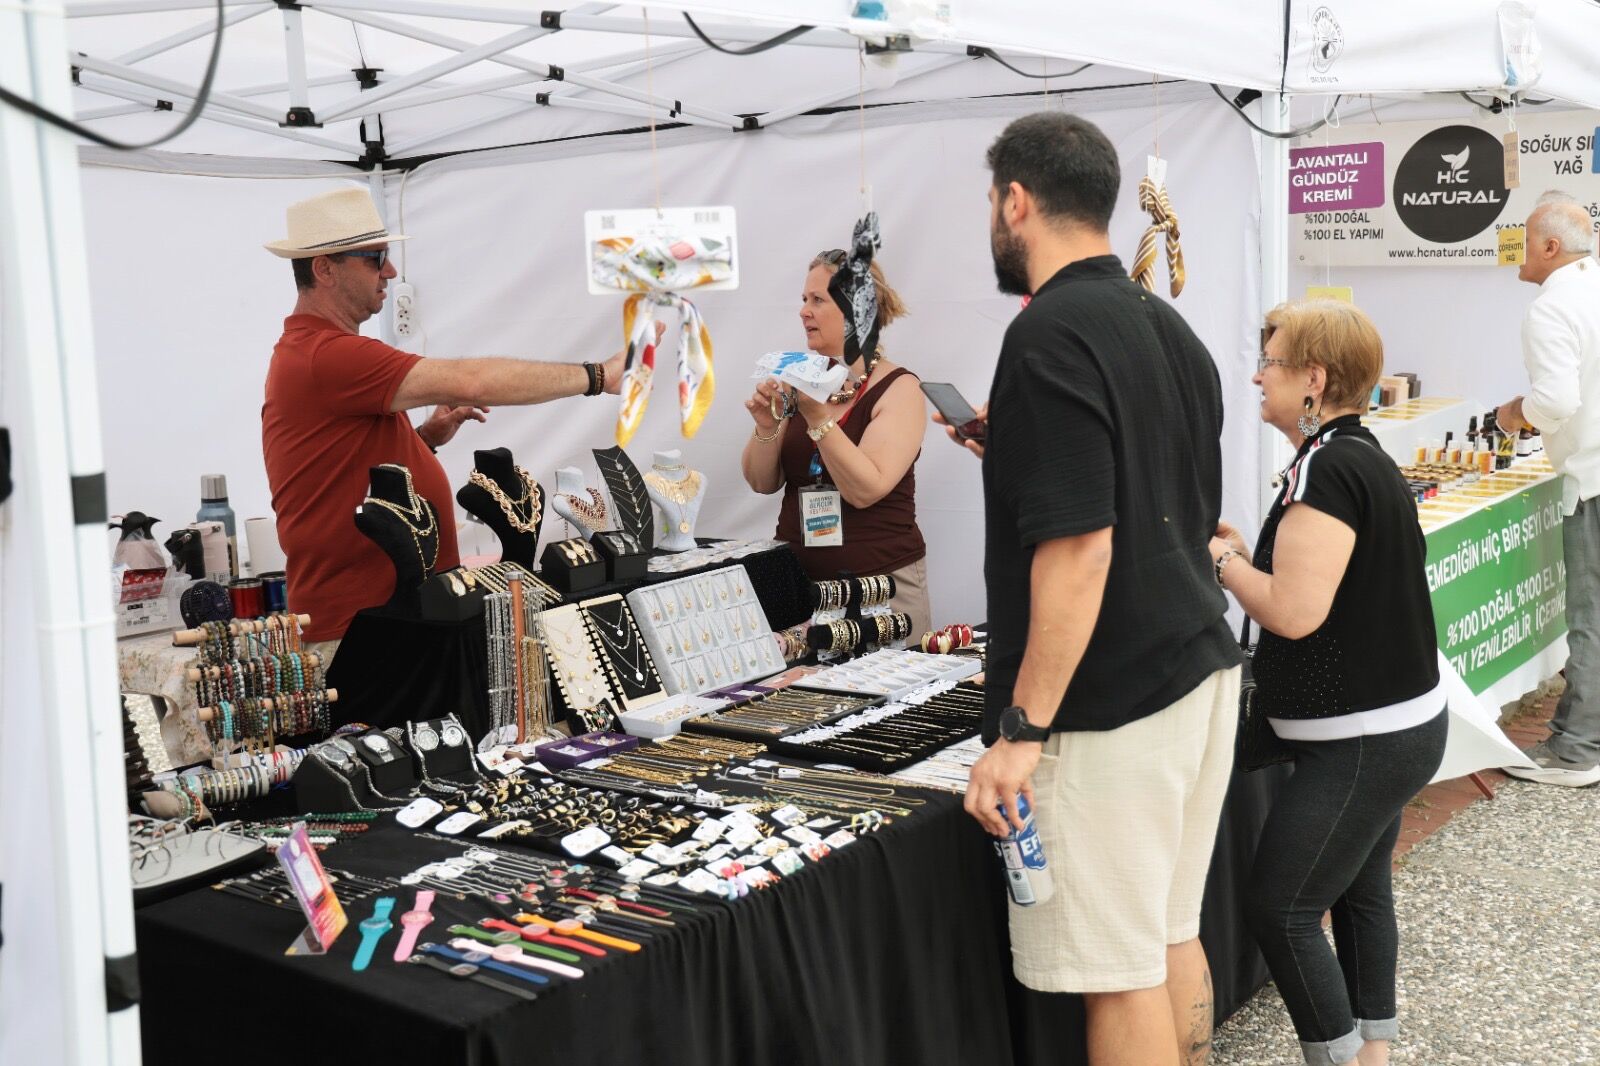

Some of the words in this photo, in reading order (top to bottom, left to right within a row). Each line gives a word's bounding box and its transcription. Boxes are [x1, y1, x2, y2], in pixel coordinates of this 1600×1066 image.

[1520, 134, 1573, 154] SOĞUK
[1576, 135, 1594, 151] SI
[1289, 151, 1368, 170] LAVANTALI
[1553, 155, 1583, 175] YAĞ
[1292, 168, 1359, 187] GÜNDÜZ
[1303, 185, 1352, 203] KREMİ
[1402, 189, 1501, 206] NATURAL
[1305, 213, 1332, 224] %100
[1334, 210, 1370, 223] DOĞAL
[1304, 229, 1331, 240] %100
[1333, 229, 1346, 239] EL
[1349, 228, 1384, 240] YAPIMI
[1388, 246, 1498, 258] www.hcnatural.com.
[1425, 539, 1480, 592] EMEDİĞİN
[1481, 529, 1500, 565] HİÇ
[1501, 520, 1521, 553] BİR
[1522, 505, 1542, 549] ŞEYİ
[1543, 500, 1563, 531] CİLD
[1446, 609, 1479, 649] %100
[1480, 588, 1515, 631] DOĞAL
[1516, 572, 1542, 608] %100
[1543, 566, 1555, 592] EL
[1556, 559, 1567, 584] YA
[1450, 652, 1468, 677] EN
[1470, 610, 1532, 672] YENİLEBİLİR
[1535, 590, 1566, 635] İÇERİKL
